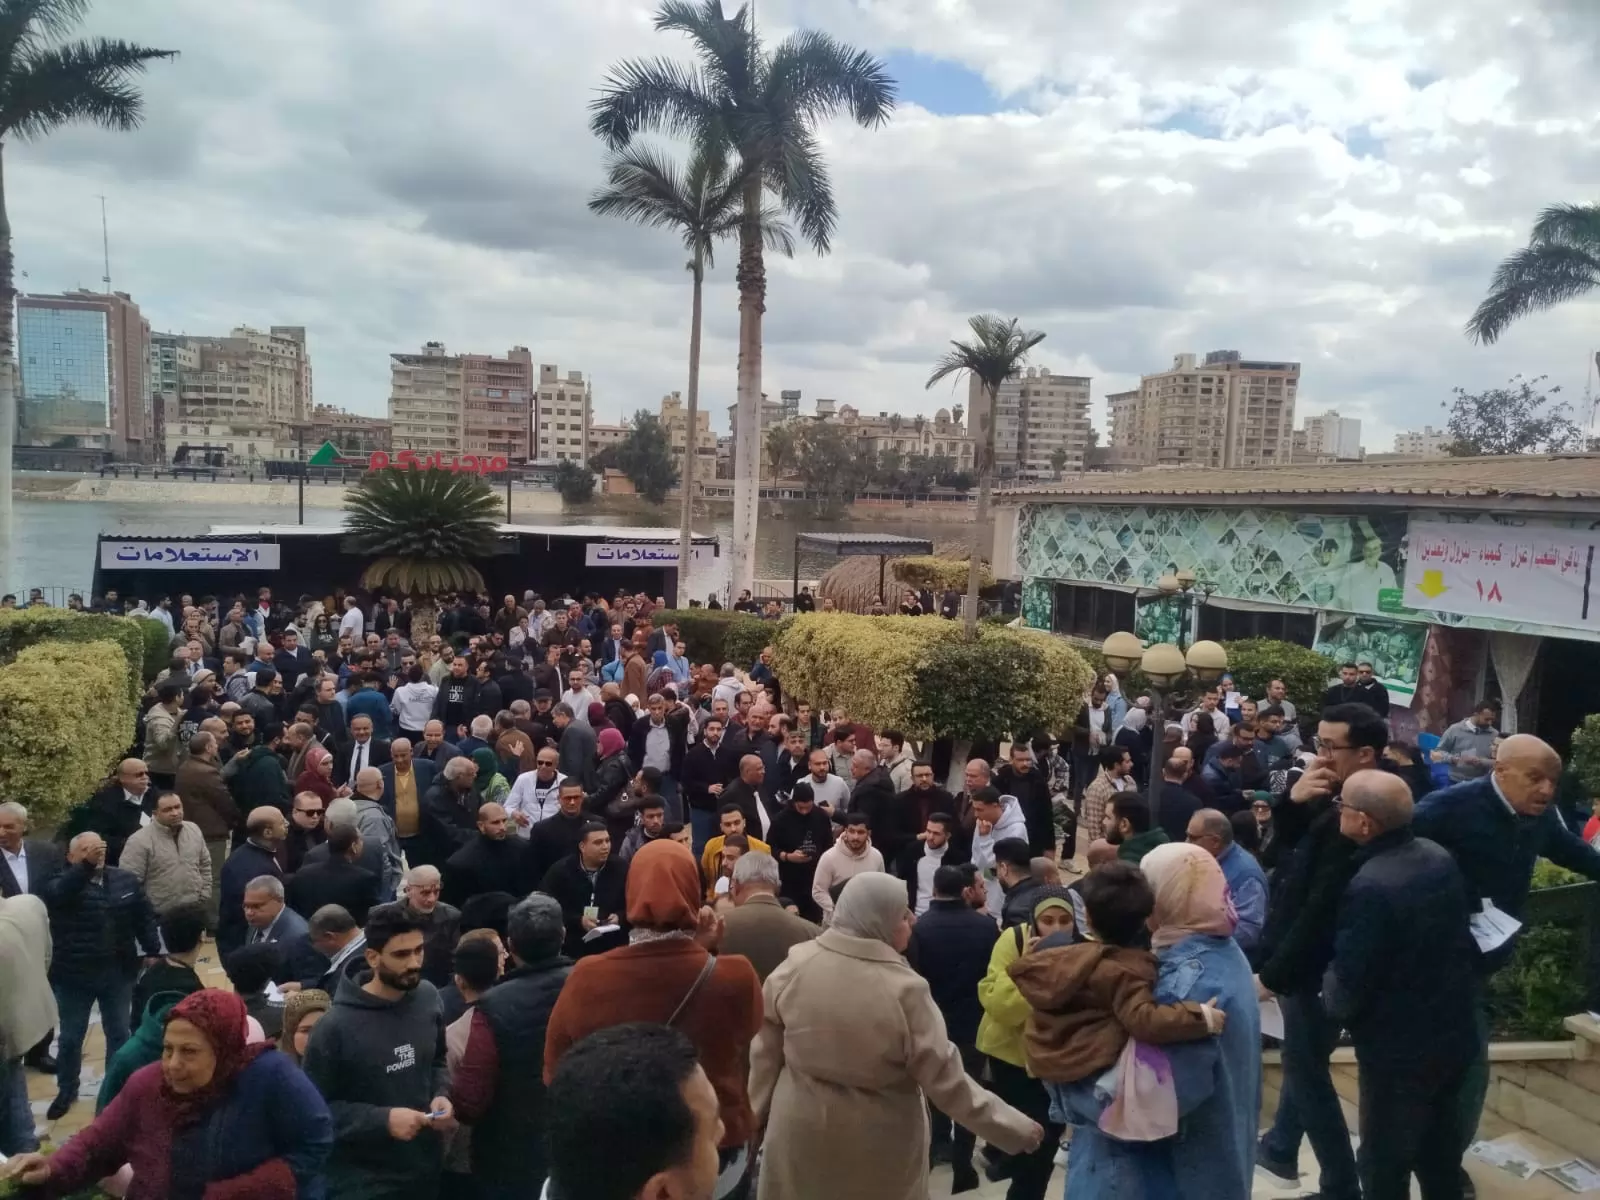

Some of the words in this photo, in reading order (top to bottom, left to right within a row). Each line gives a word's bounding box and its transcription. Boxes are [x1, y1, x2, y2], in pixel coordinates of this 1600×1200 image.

[116, 547, 259, 566] الإستعلامات
[1476, 578, 1503, 602] ١٨
[394, 1044, 415, 1055] FEEL
[398, 1050, 416, 1061] THE
[386, 1057, 416, 1073] POWER
